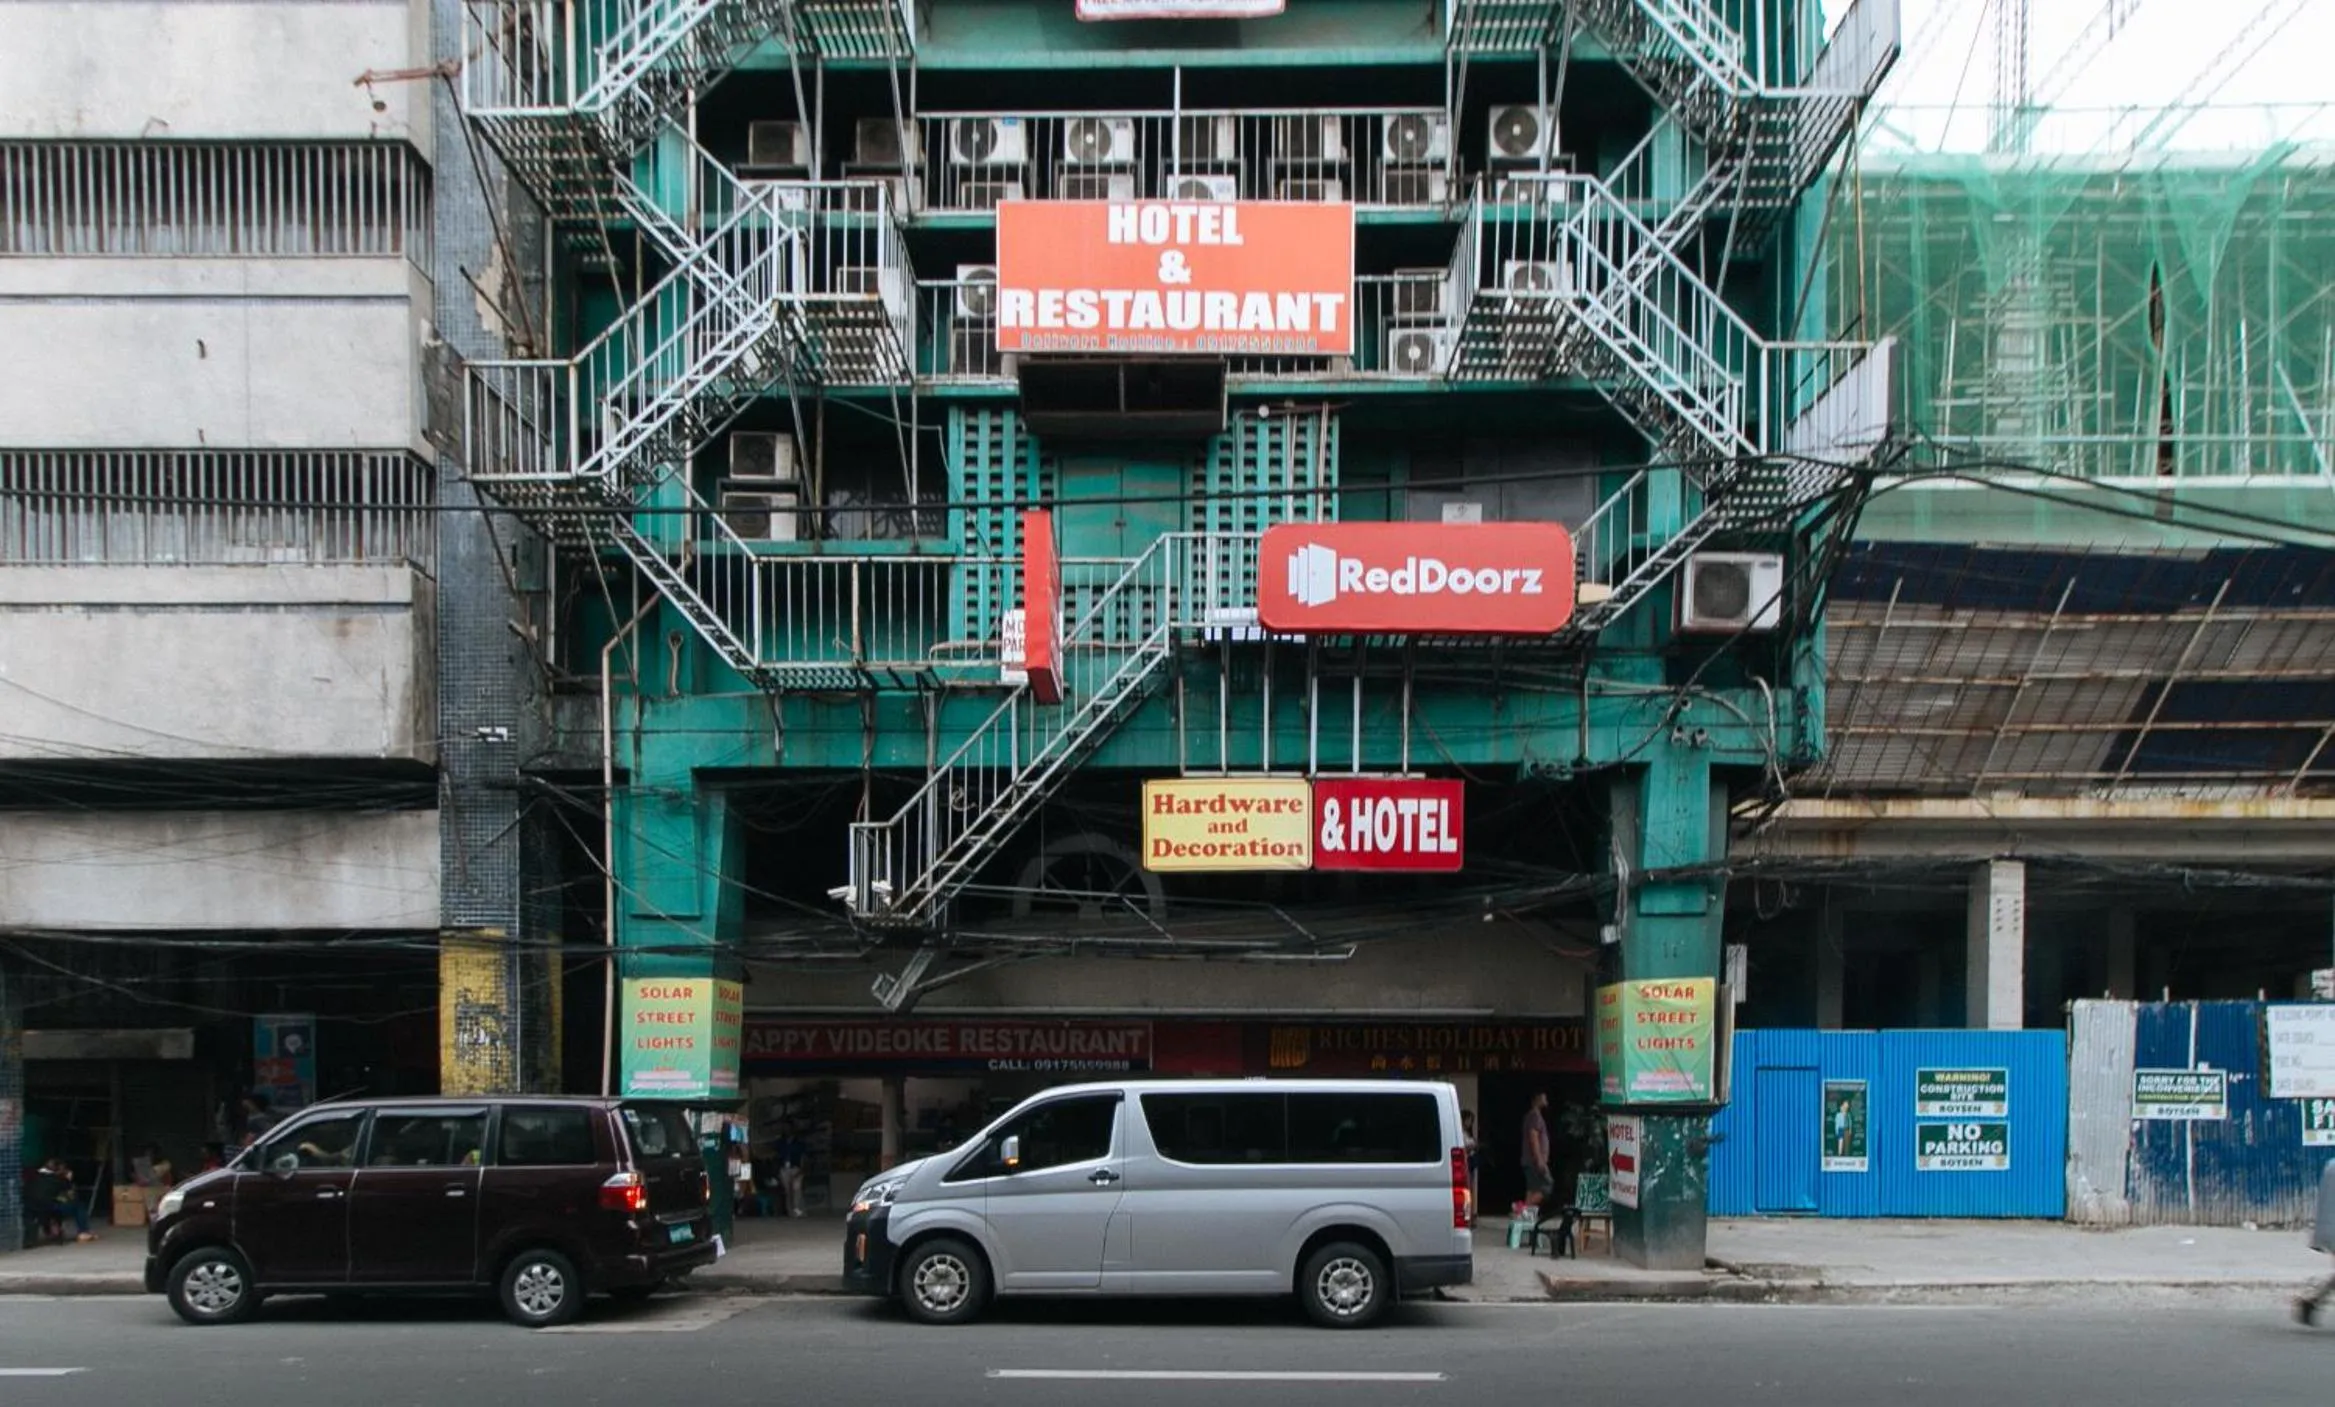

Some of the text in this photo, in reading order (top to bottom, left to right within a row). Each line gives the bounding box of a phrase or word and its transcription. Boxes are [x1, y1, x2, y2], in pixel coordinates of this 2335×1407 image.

[1108, 204, 1243, 245] HOTEL
[1158, 249, 1191, 284] &
[1000, 289, 1345, 332] RESTAURANT
[1340, 556, 1543, 594] RedDoorz
[1153, 793, 1304, 815] Hardware
[1208, 818, 1248, 834] and
[1152, 837, 1304, 858] Decoration
[640, 986, 694, 999] SOLAR
[1641, 985, 1695, 999] SOLAR
[636, 1011, 696, 1024] STREET
[1636, 1011, 1697, 1024] STREET
[637, 1037, 694, 1050] LIGHTS
[747, 1027, 1146, 1054] APPY VIDEOKE RESTAURANT
[1320, 1027, 1411, 1048] RICHES
[1417, 1026, 1524, 1049] HOLIDAY
[1638, 1037, 1695, 1050] LIGHTS
[2139, 1075, 2174, 1085] SORRY
[1920, 1084, 2005, 1093] CONSTRUCTION
[1939, 1104, 1981, 1113] BOYSEN
[1609, 1122, 1635, 1142] HOTEL
[1947, 1123, 1981, 1140] NO
[1925, 1140, 2003, 1155] PARKING
[1940, 1158, 1983, 1167] BOYSEN
